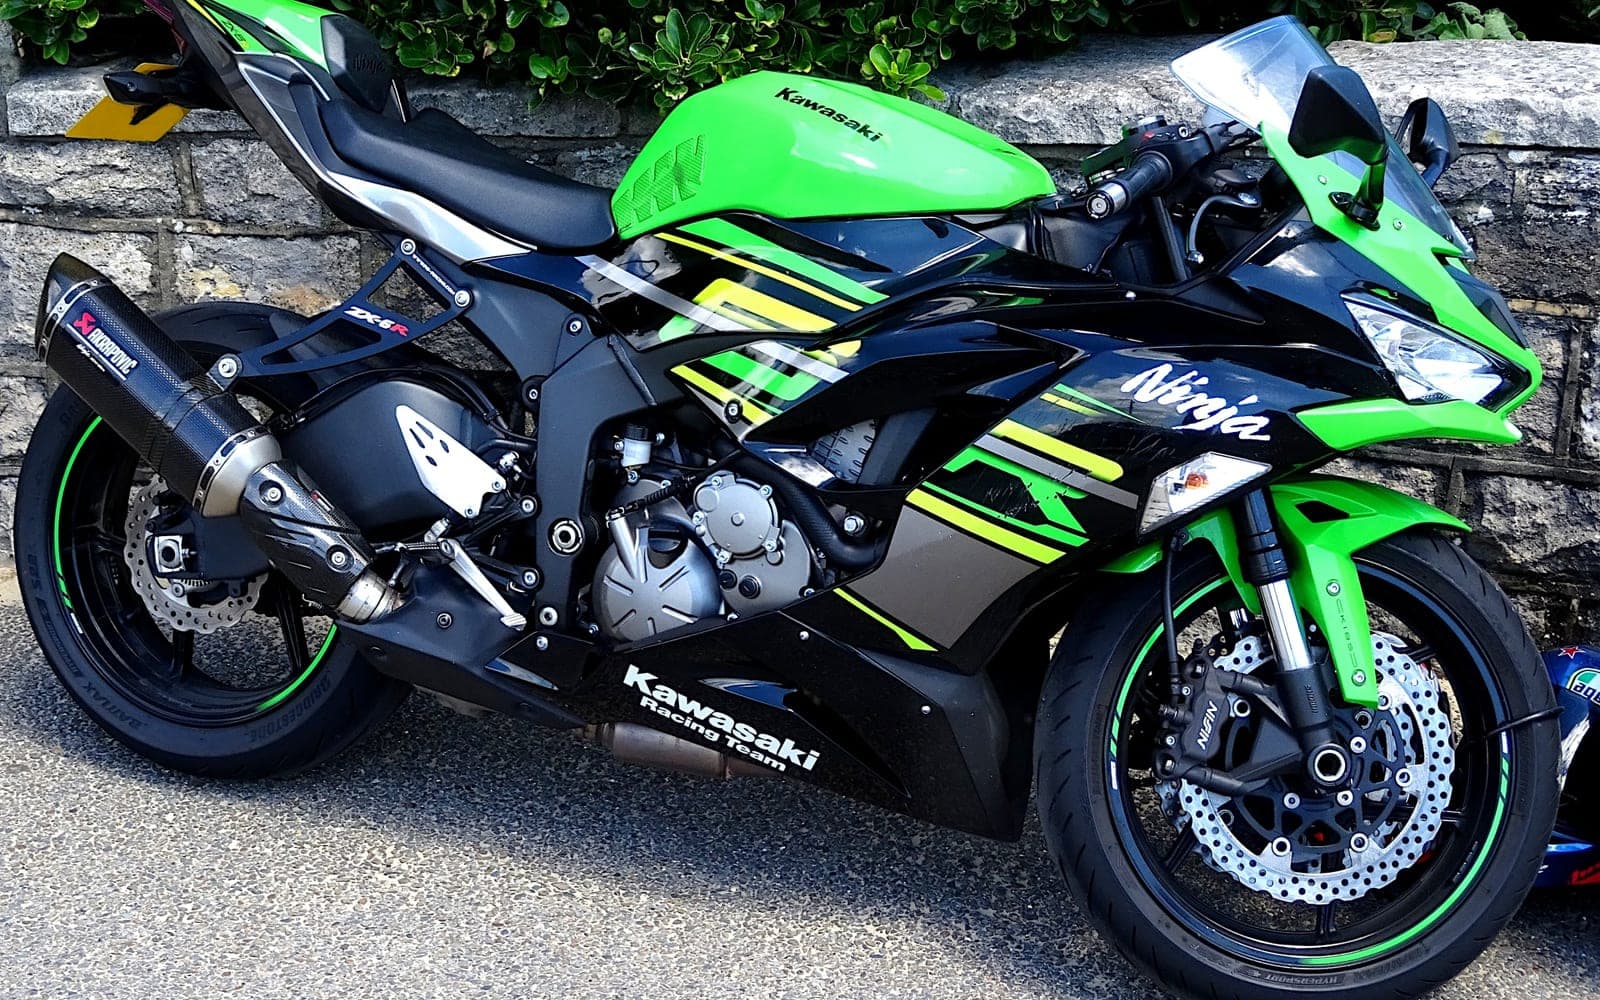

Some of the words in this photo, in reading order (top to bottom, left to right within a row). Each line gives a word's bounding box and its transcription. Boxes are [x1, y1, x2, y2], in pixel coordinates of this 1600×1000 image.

[774, 87, 884, 142] Kawasaki
[343, 306, 409, 337] ZX-6R
[1120, 363, 1271, 441] Ninja
[623, 663, 821, 771] Kawasaki
[640, 696, 721, 742] Racing
[725, 735, 787, 772] Team
[1264, 973, 1338, 985] HYPERSPORT
